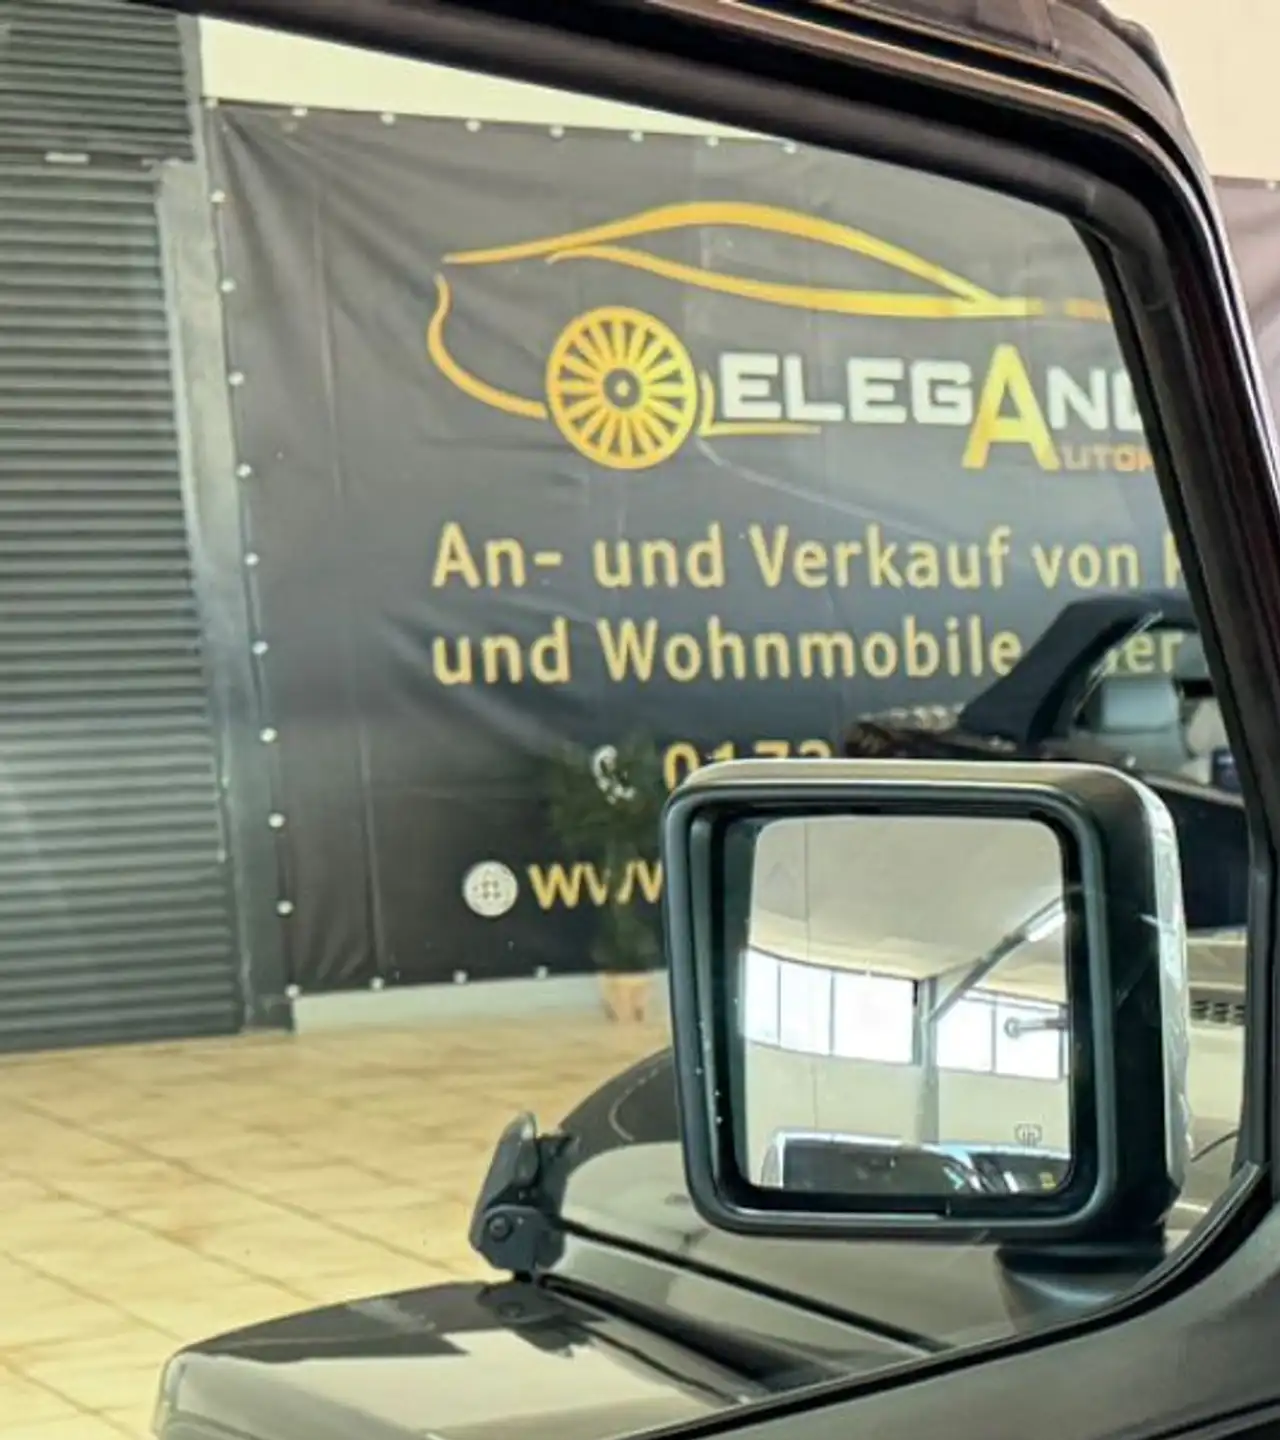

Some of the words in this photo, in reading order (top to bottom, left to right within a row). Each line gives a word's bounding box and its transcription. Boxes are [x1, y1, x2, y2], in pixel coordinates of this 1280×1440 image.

[431, 521, 563, 589] An-
[593, 520, 726, 589] und
[747, 522, 1012, 589] Verkauf
[1030, 541, 1139, 589] von
[431, 615, 571, 686] und
[596, 614, 1023, 683] Wohnmobile
